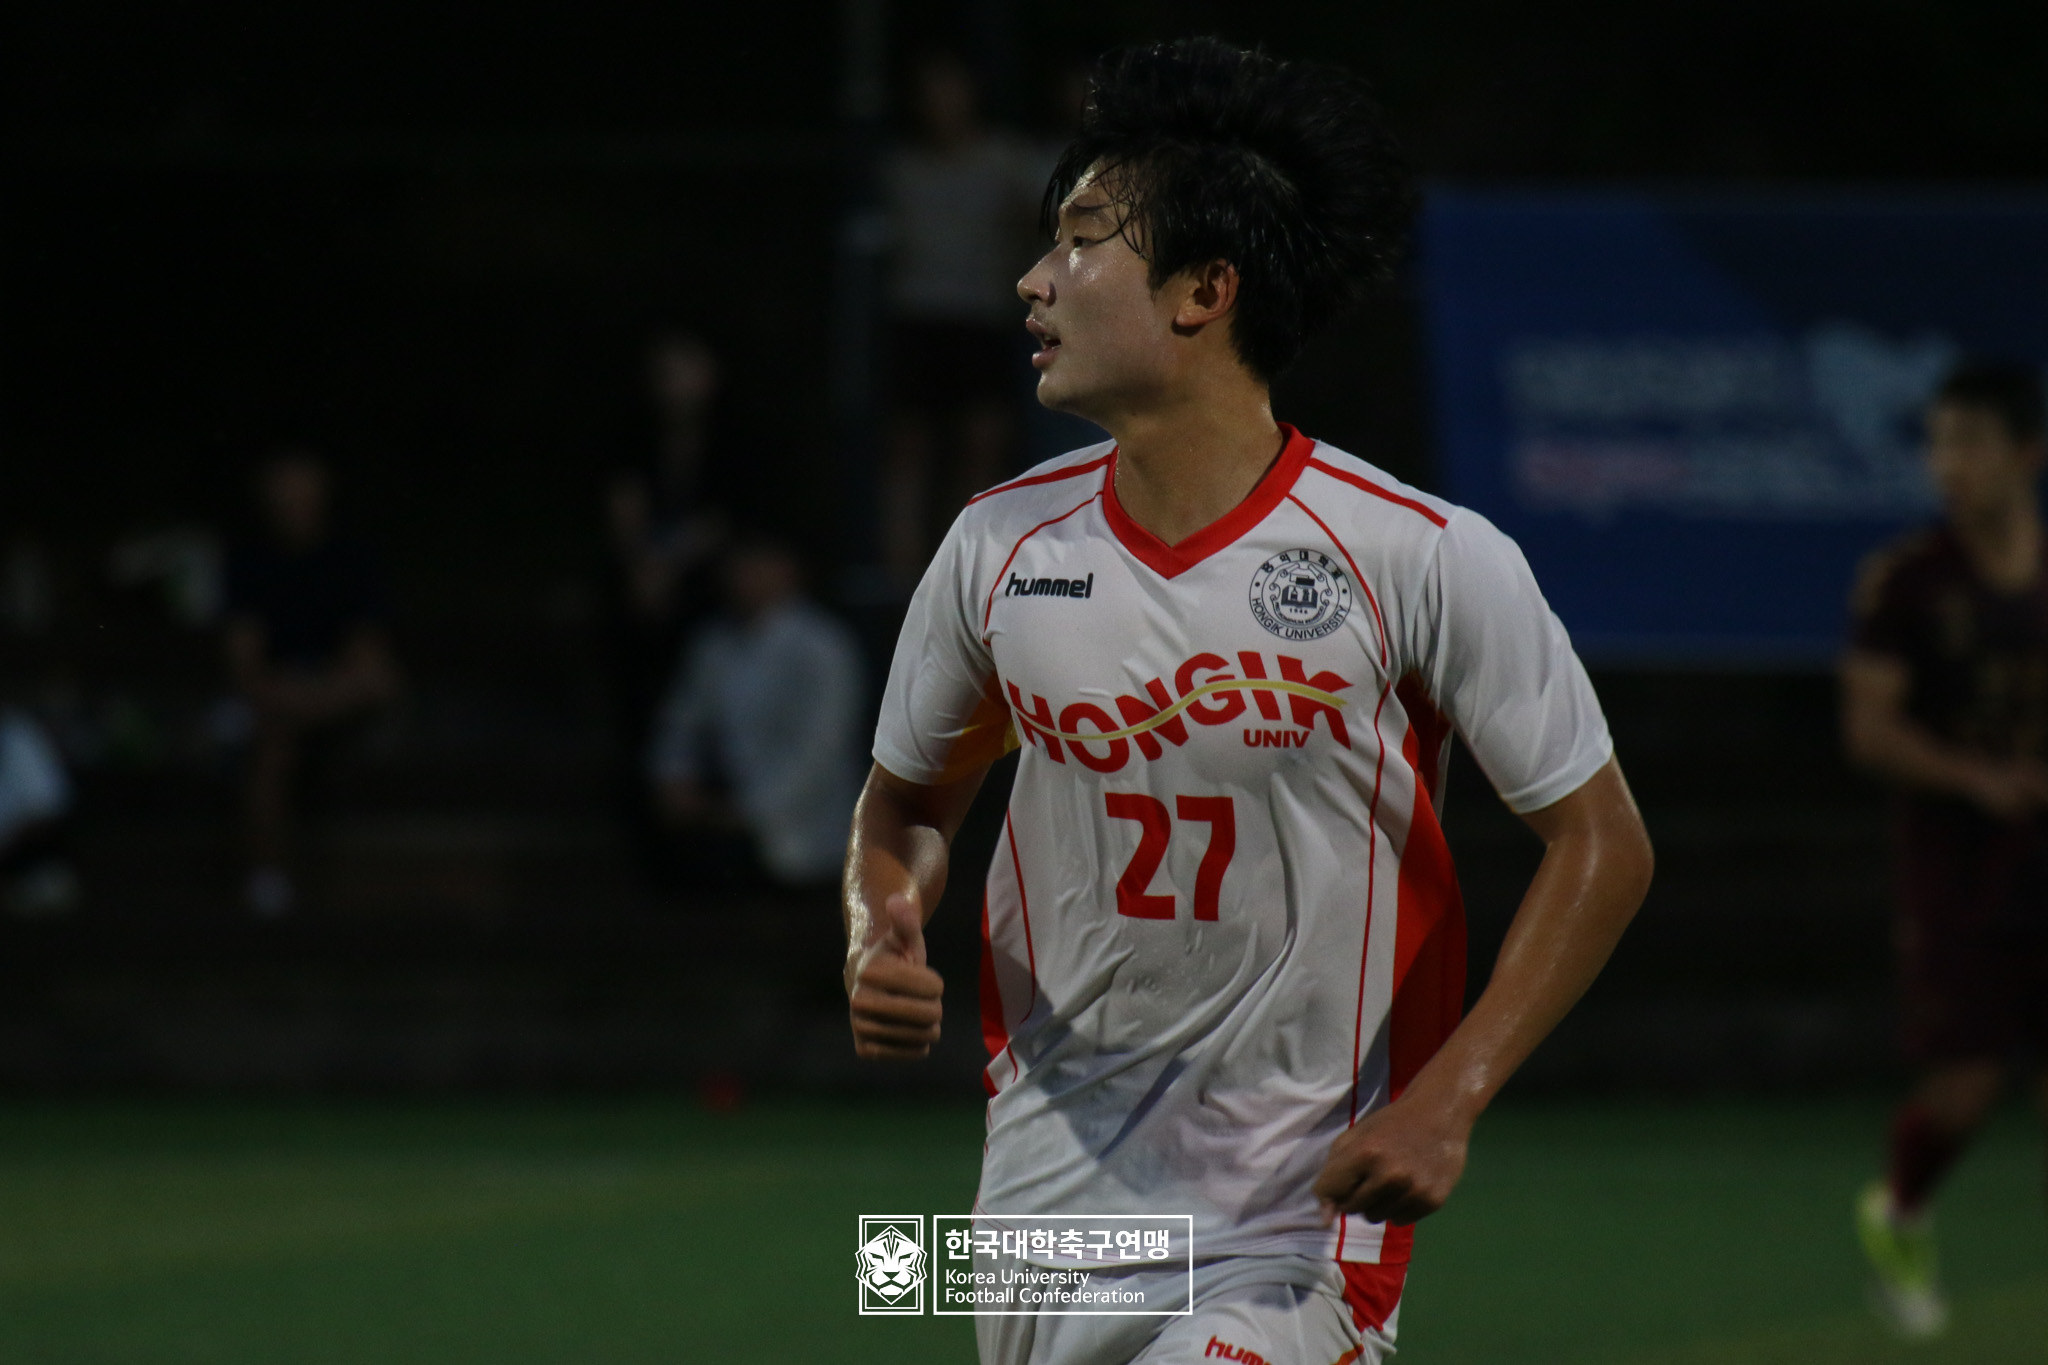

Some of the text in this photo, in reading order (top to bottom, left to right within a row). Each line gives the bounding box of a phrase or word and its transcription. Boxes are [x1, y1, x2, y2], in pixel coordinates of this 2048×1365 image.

[1005, 572, 1094, 599] hummel
[1252, 597, 1284, 635] HONGIK
[1285, 604, 1347, 639] UNIVERSITY
[1006, 651, 1354, 774] HONGIK
[1243, 729, 1310, 748] UNIV
[1104, 792, 1236, 922] 27
[1204, 1334, 1272, 1365] hum
